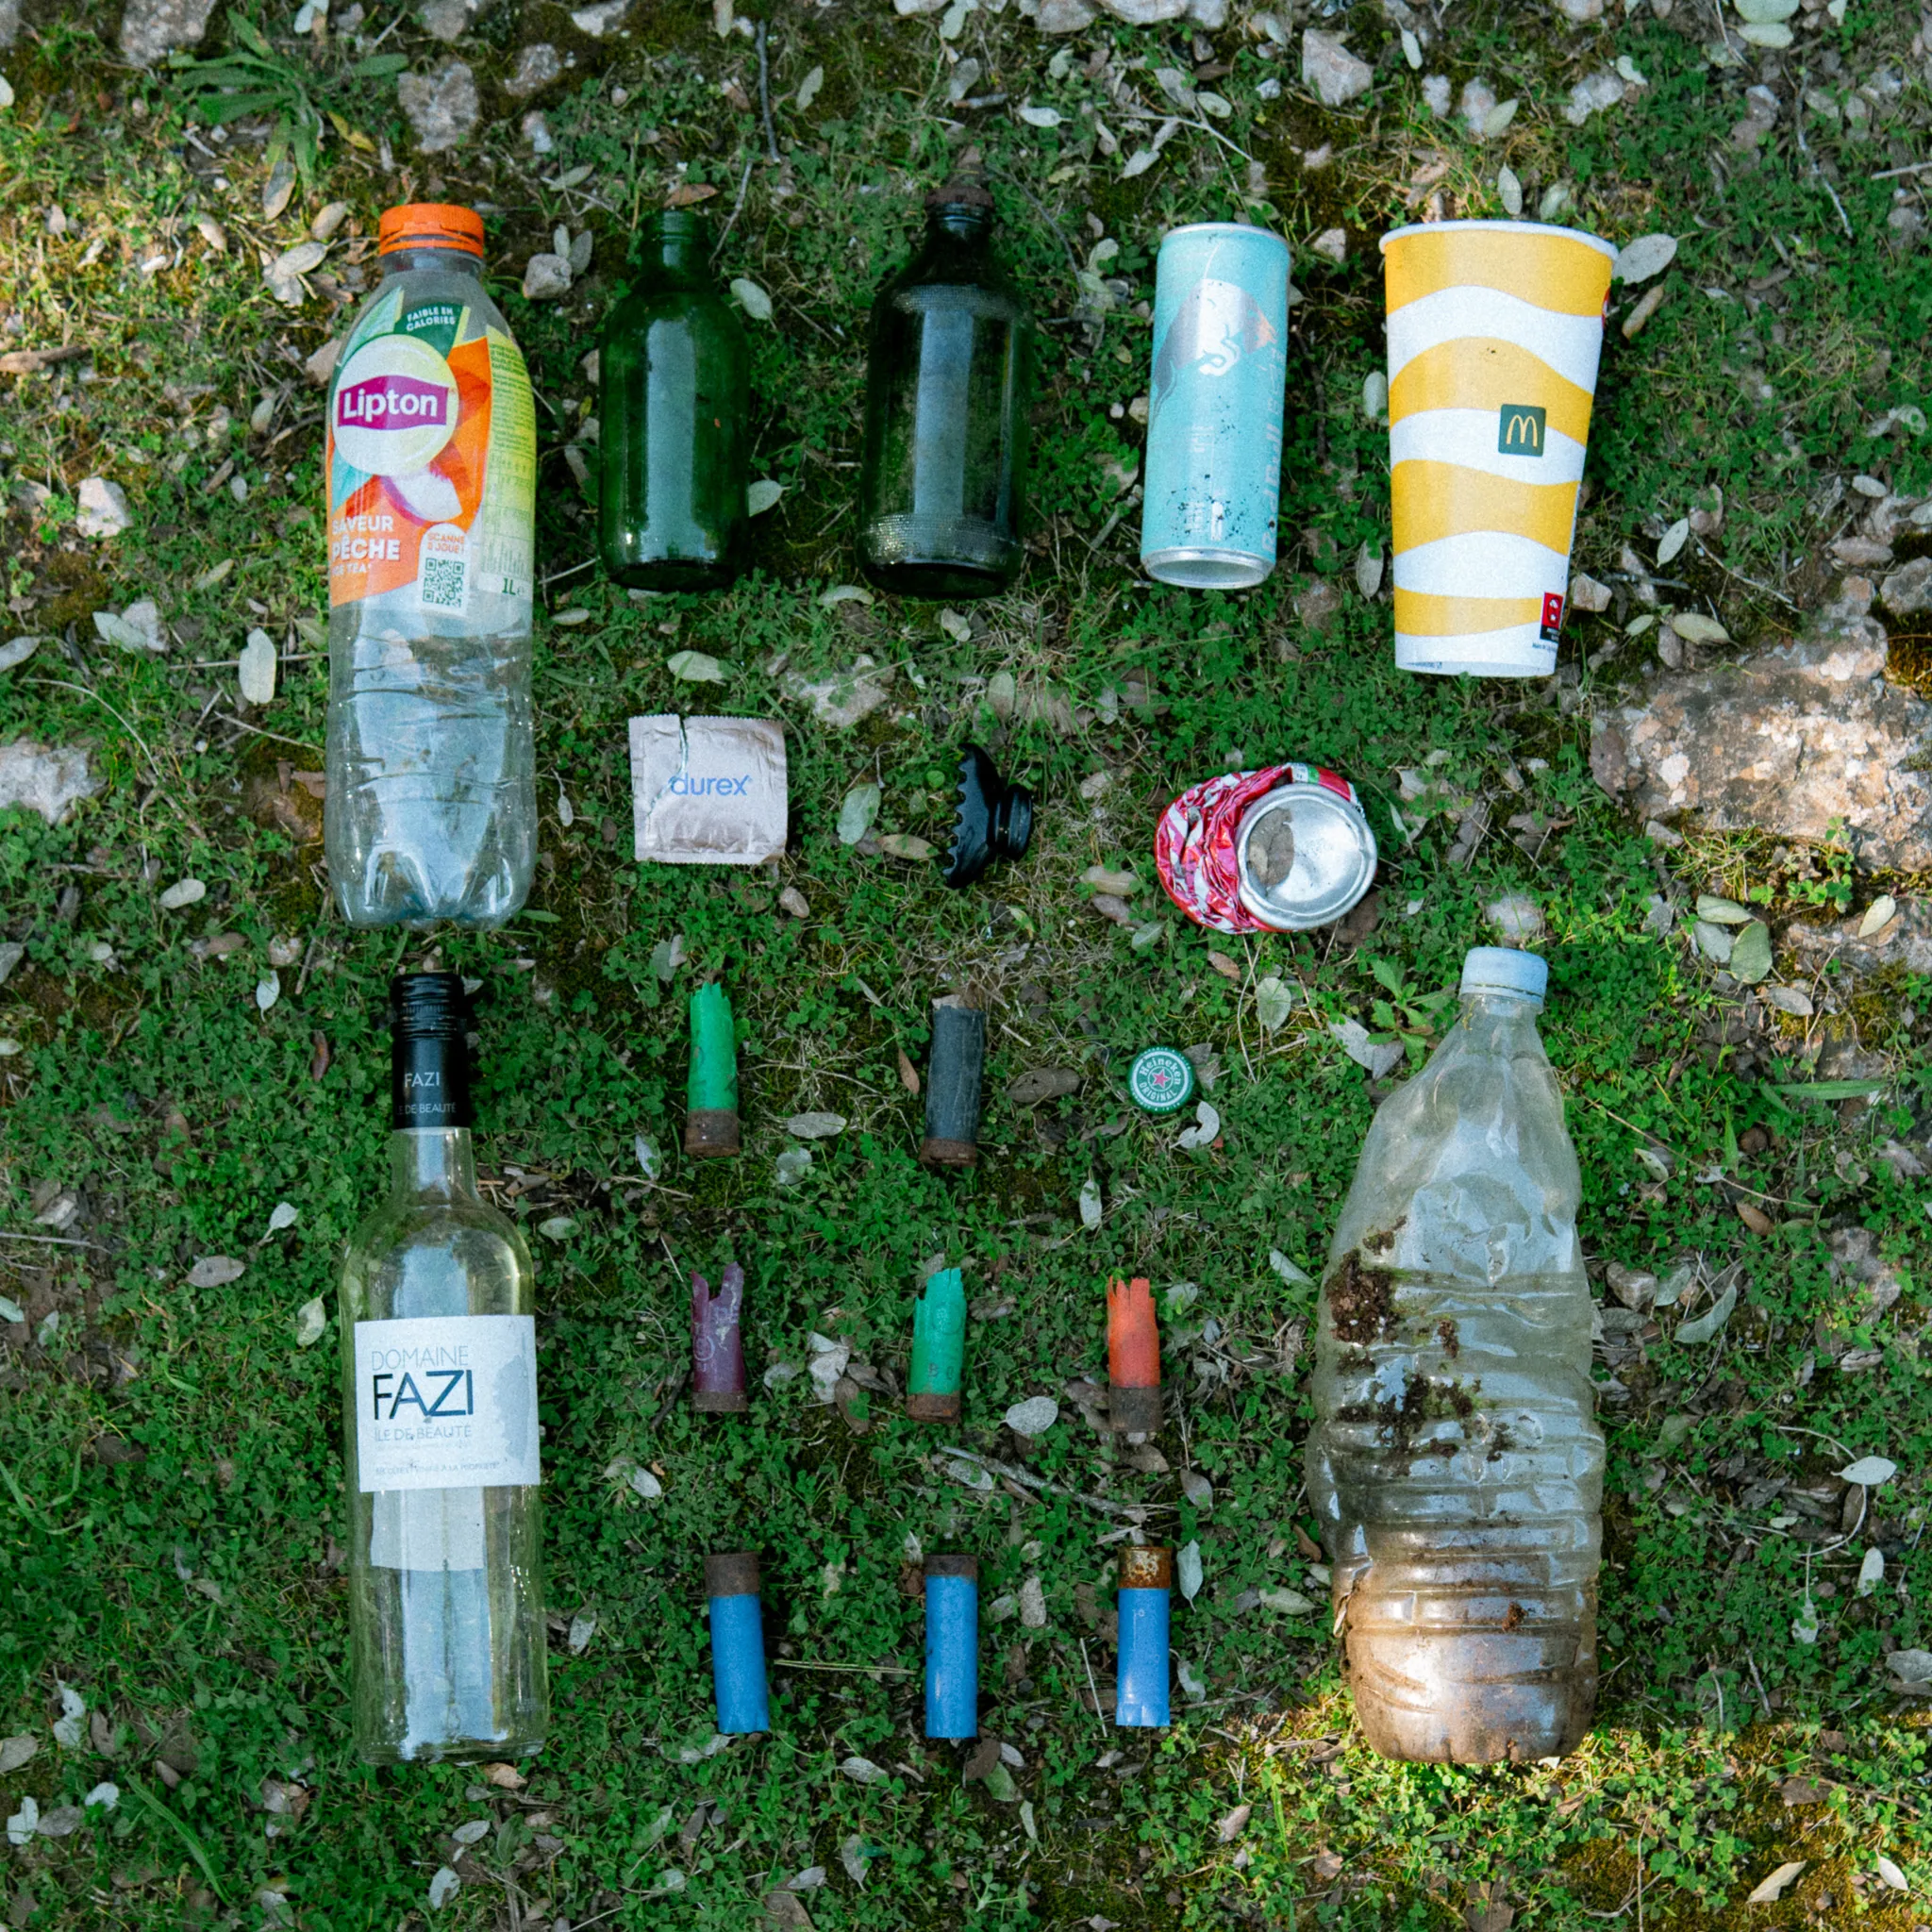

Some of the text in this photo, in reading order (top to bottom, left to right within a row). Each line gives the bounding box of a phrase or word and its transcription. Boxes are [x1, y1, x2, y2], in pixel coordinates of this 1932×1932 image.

[406, 316, 457, 331] CALORIES
[407, 306, 453, 323] FAIBLE EN
[343, 388, 438, 423] Lipton
[332, 515, 393, 536] SAVEUR
[332, 534, 401, 562] PÊCHE
[427, 532, 465, 545] SCANNE
[668, 772, 750, 796] durex
[404, 1071, 440, 1088] FAZI
[1140, 1058, 1181, 1085] Heineken
[1140, 1082, 1177, 1102] ORIGINAL
[405, 1104, 417, 1114] DE
[371, 1345, 469, 1371] DOMAINE
[373, 1369, 474, 1421] FAZI
[393, 1427, 412, 1441] DE
